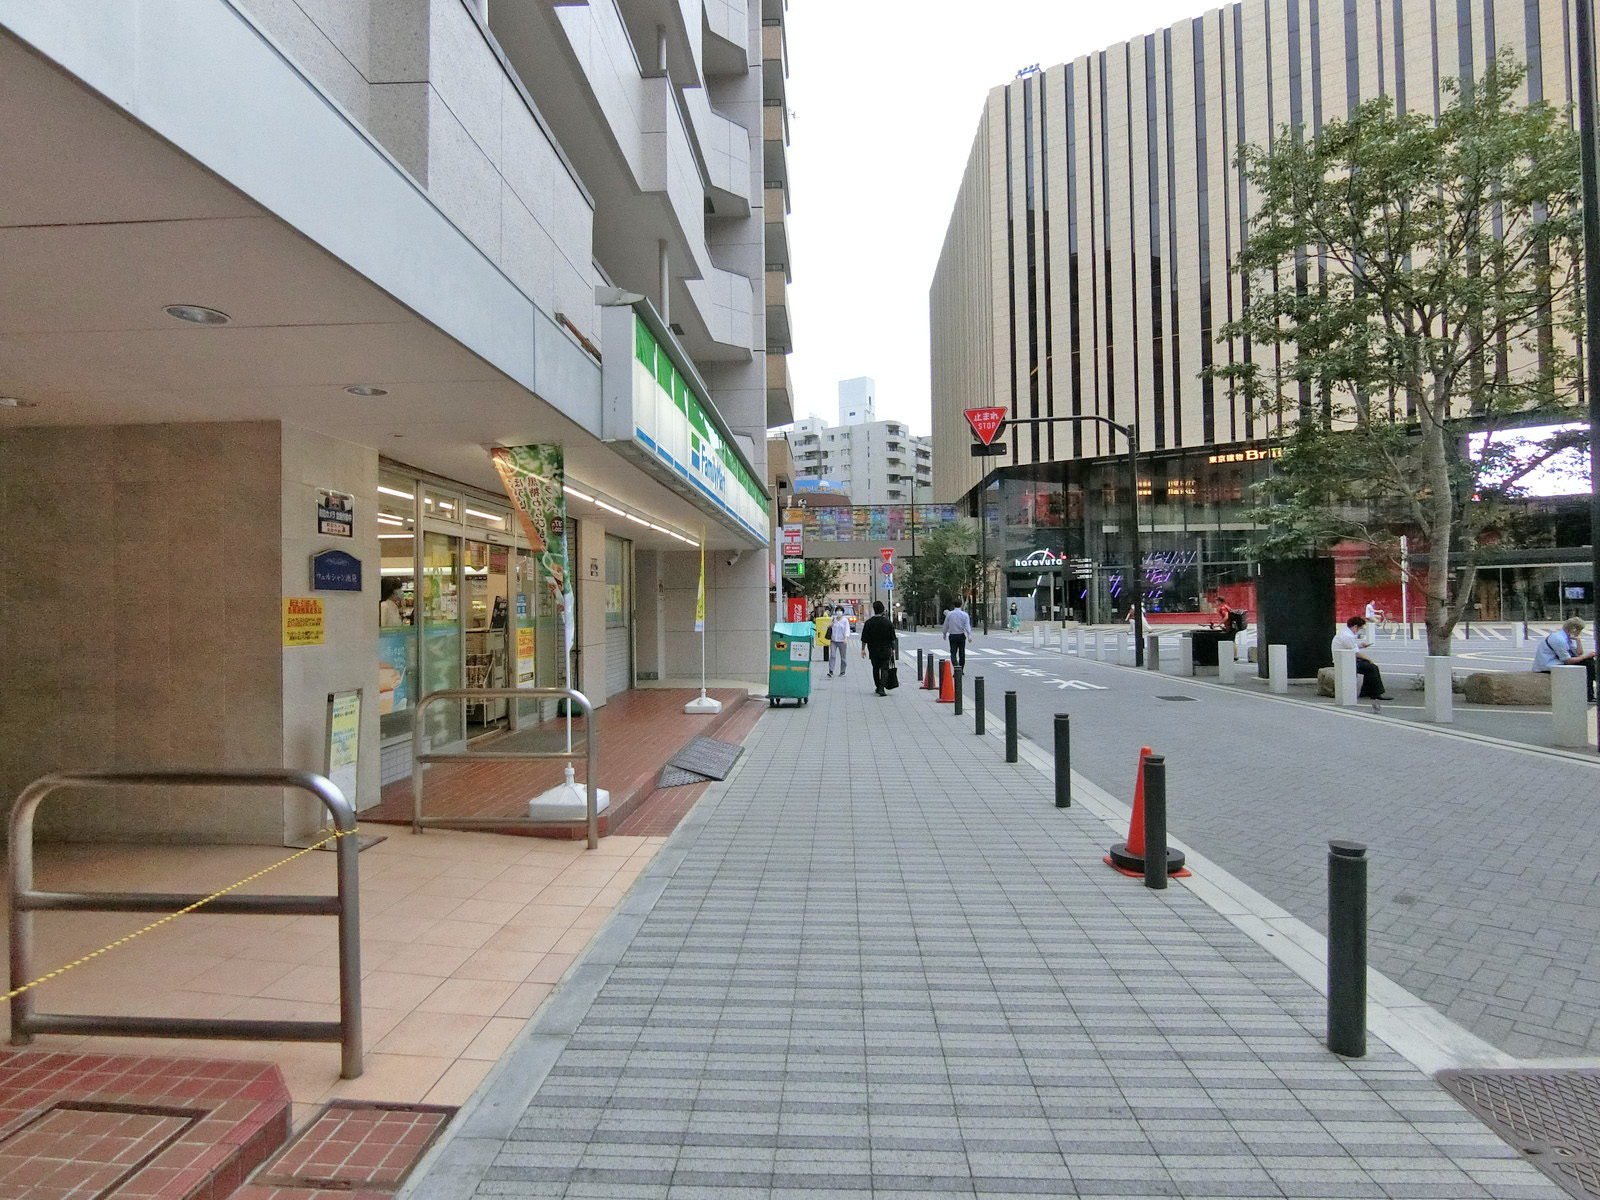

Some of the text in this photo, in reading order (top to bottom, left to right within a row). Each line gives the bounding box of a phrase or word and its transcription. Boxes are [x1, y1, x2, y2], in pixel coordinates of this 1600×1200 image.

[973, 411, 999, 422] 止まれ
[978, 422, 996, 430] STOP
